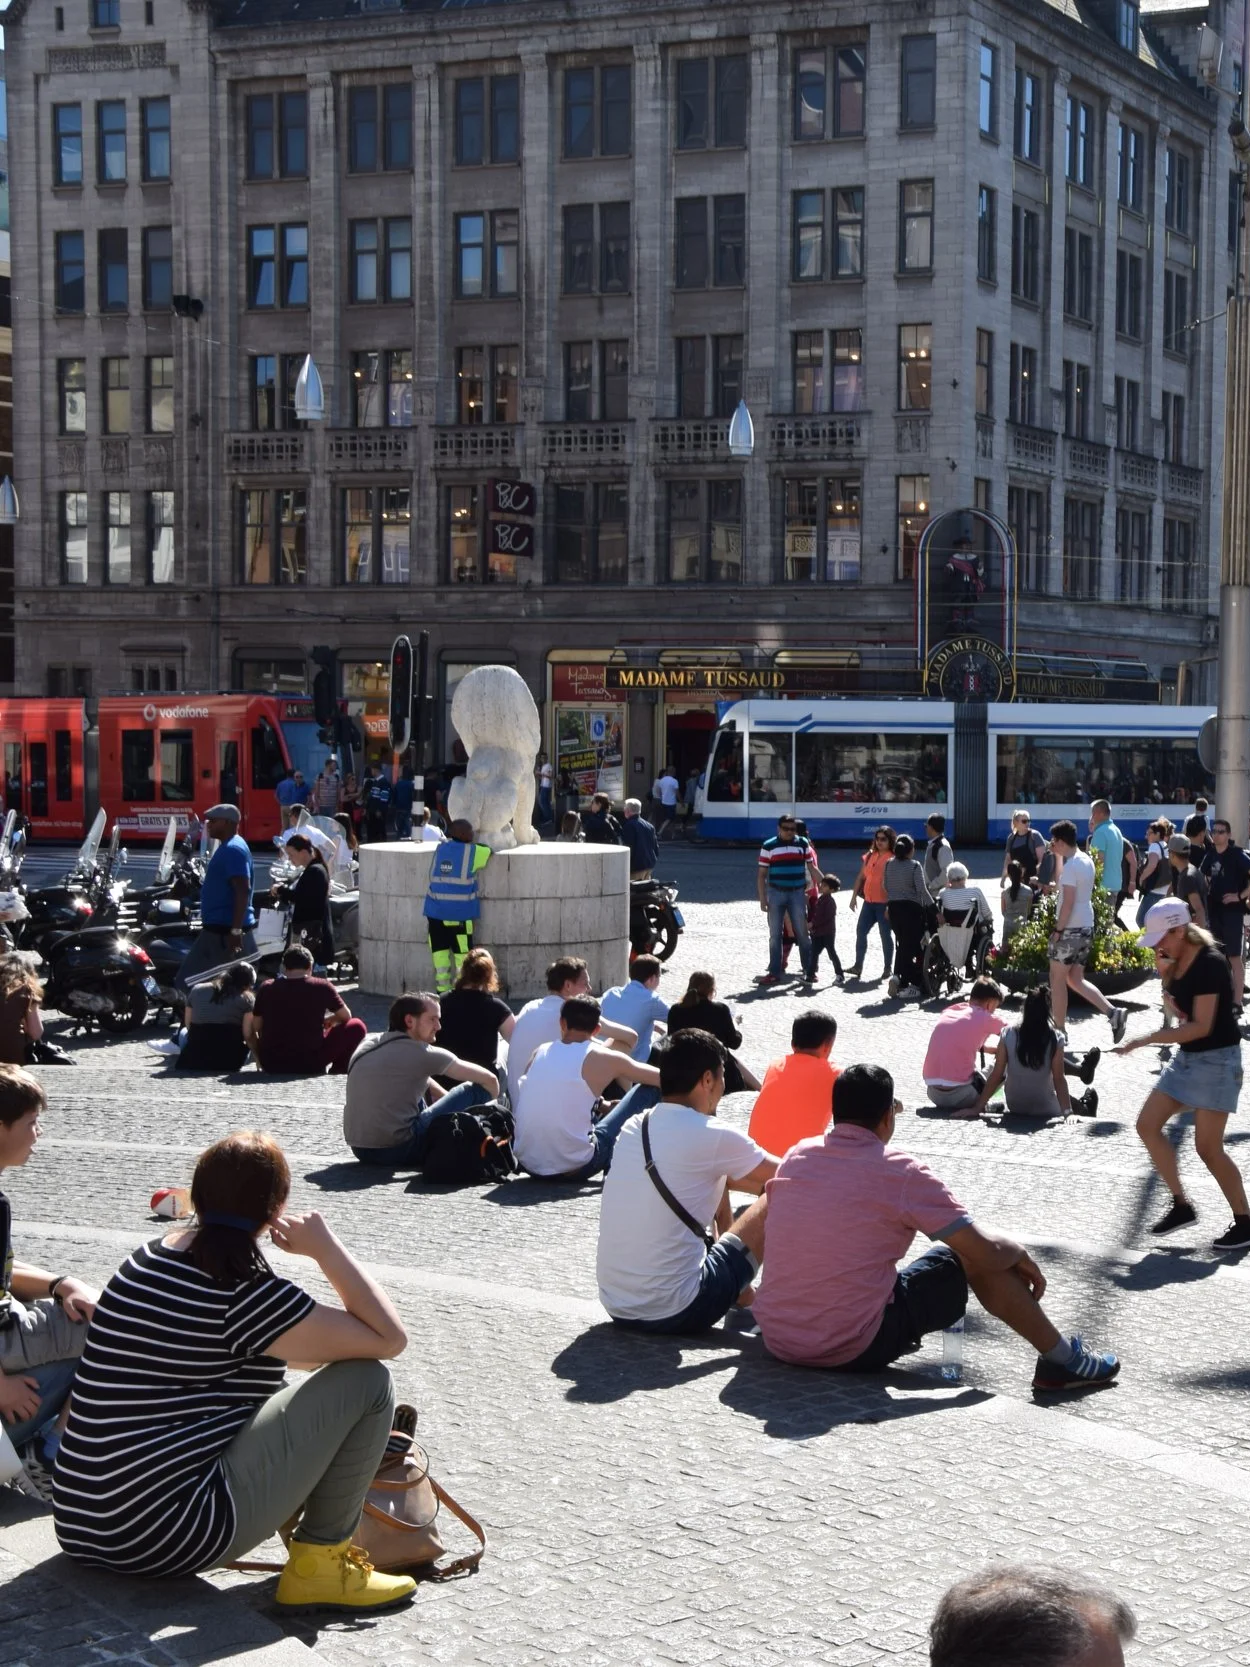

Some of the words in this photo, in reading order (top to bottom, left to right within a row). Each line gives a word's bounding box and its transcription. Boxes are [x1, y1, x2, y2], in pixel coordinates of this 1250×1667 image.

[929, 639, 972, 683] MADAME
[975, 639, 1013, 685] TUSSAUD
[619, 670, 697, 687] MADAME
[703, 670, 786, 687] TUSSAUD
[1021, 676, 1063, 695] MADAME
[1066, 680, 1105, 698] TUSSAUD
[159, 705, 209, 718] vodafone
